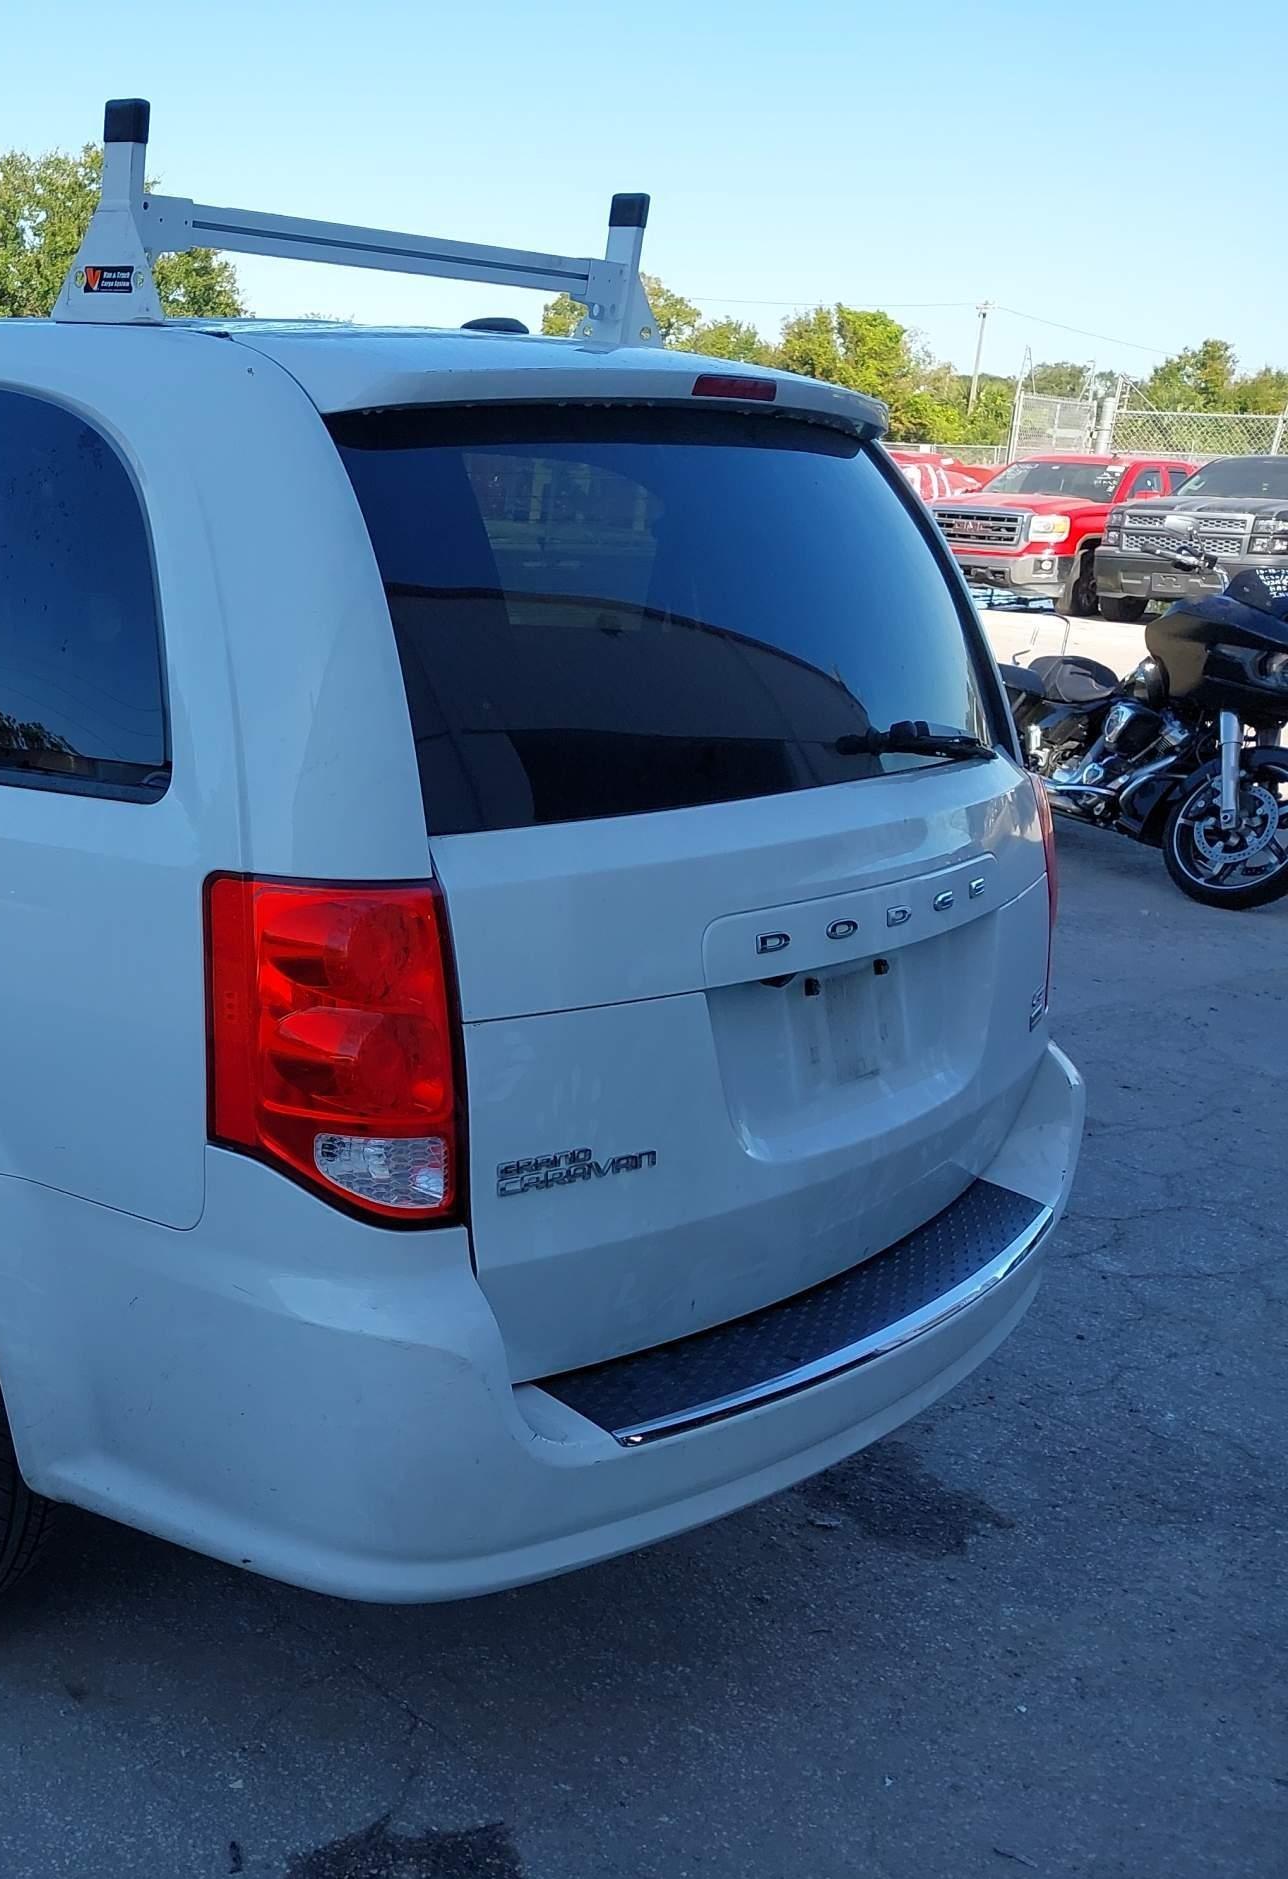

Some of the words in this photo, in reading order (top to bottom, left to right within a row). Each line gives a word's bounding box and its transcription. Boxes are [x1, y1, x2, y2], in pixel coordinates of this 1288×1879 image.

[756, 877, 986, 955] DODGE
[497, 1147, 592, 1178] GRAND
[497, 1149, 657, 1197] CARAVAN
